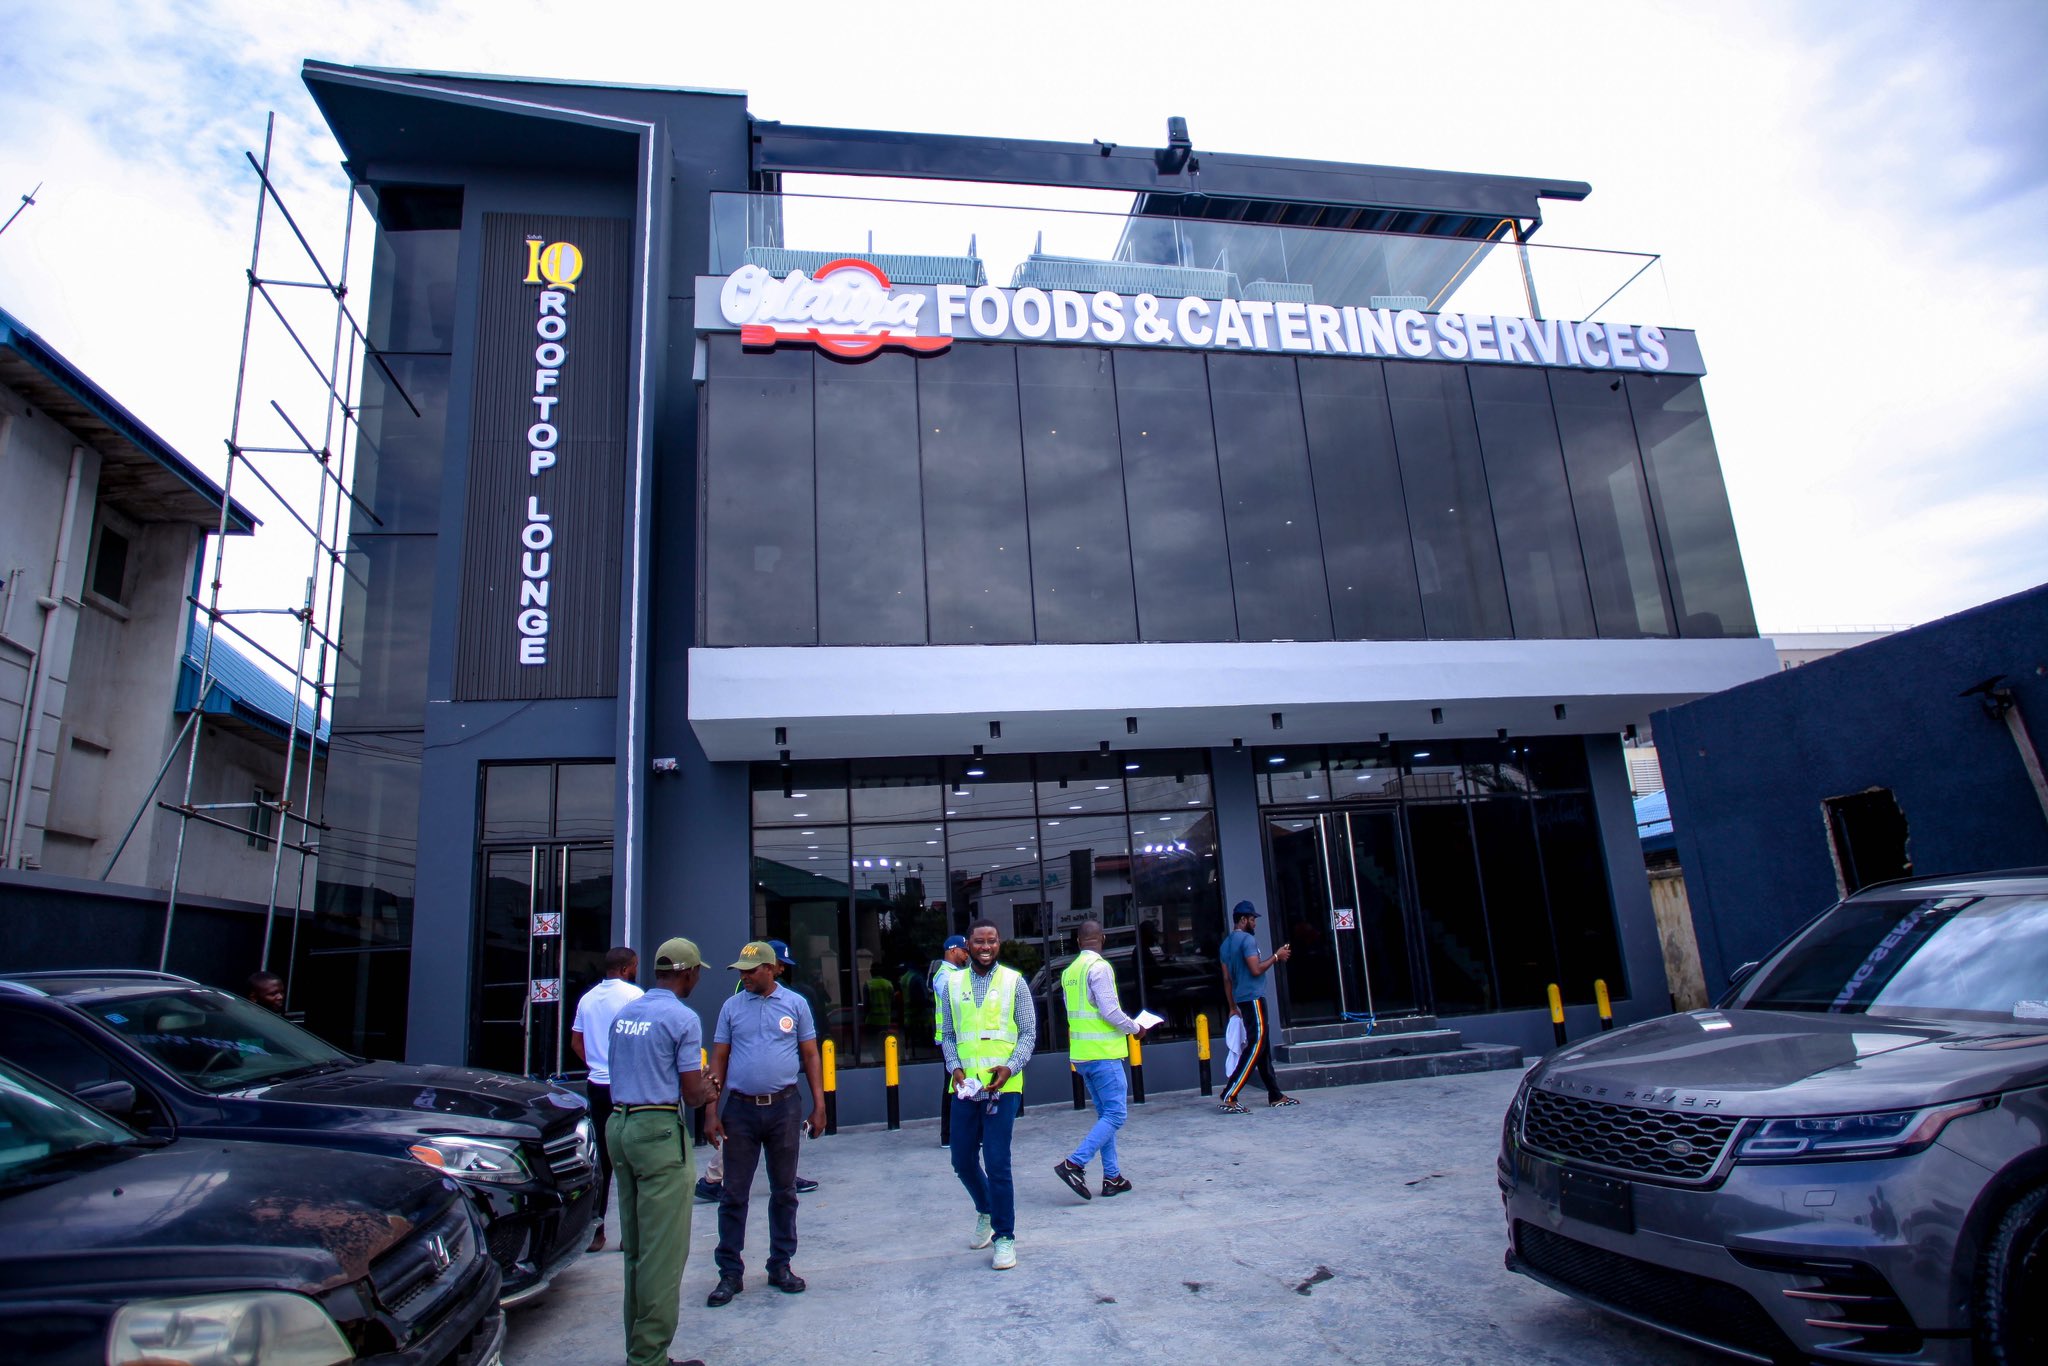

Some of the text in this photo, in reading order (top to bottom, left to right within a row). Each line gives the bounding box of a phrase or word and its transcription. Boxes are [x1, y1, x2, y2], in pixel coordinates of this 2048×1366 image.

[937, 283, 1124, 342] FOODS
[1132, 293, 1175, 344] &
[1175, 295, 1432, 358] CATERING
[1436, 312, 1670, 371] SERVICES
[517, 290, 567, 665] ROOFTOP LOUNGE
[615, 1018, 652, 1036] STAFF
[1543, 1078, 1721, 1108] RANGE ROVER
